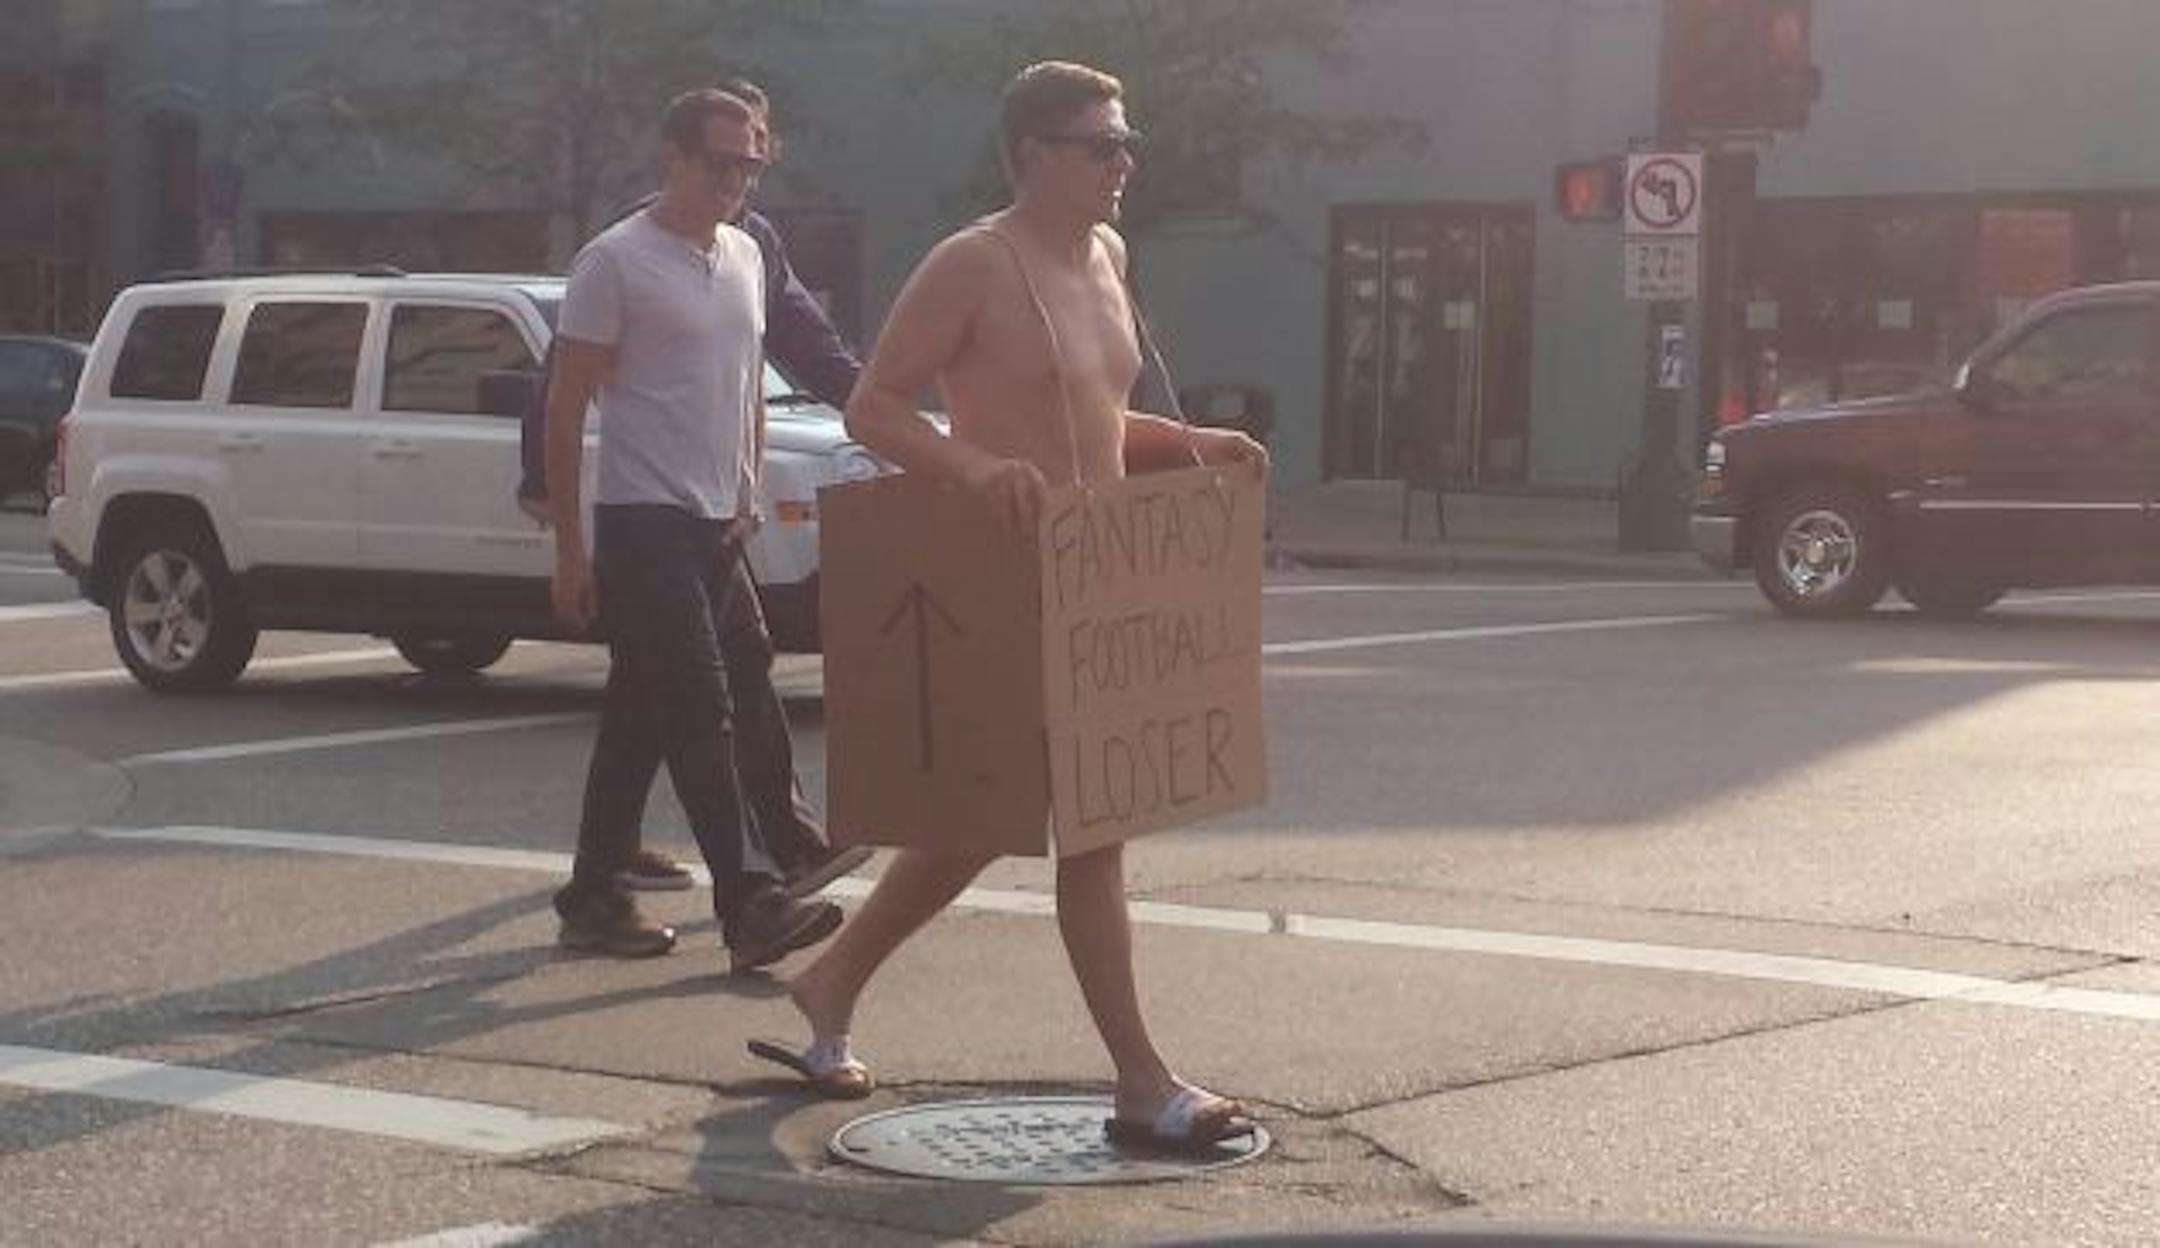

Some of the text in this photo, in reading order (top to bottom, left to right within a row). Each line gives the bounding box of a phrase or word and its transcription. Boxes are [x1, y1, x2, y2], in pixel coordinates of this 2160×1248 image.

[1052, 488, 1236, 608] FANTASY
[1069, 602, 1256, 711] FOOTBALL
[1075, 707, 1236, 828] LOSER
